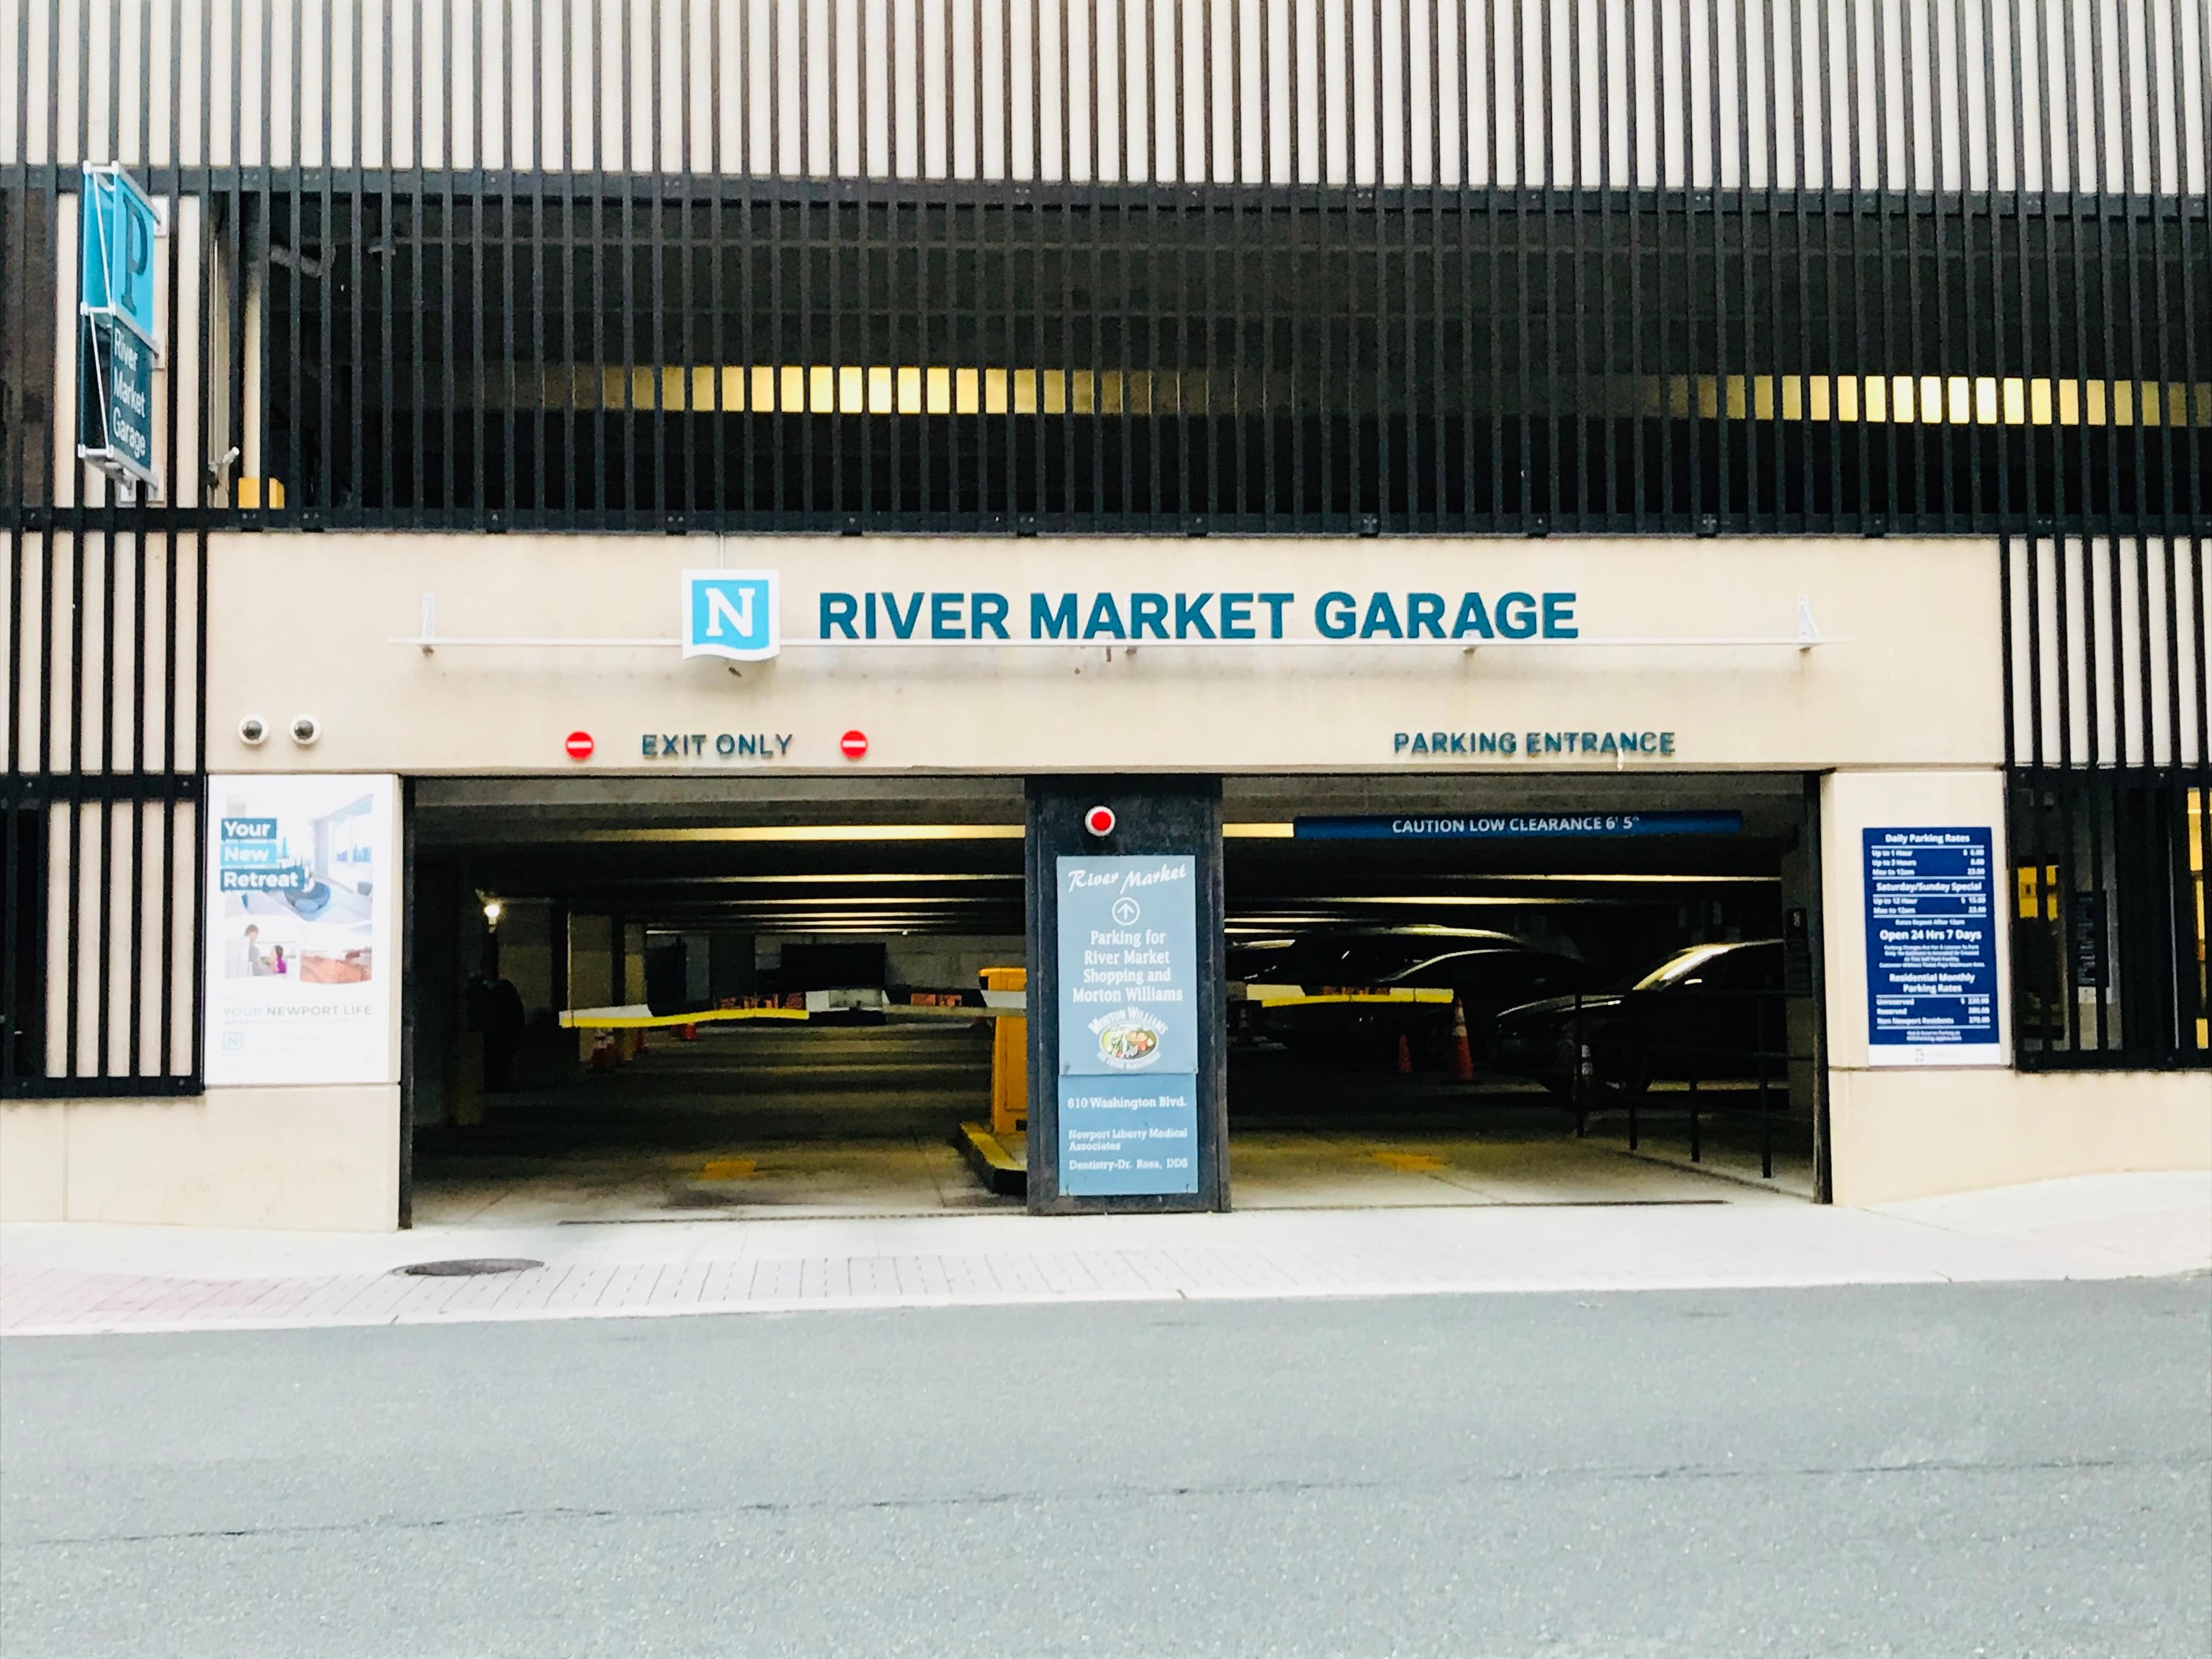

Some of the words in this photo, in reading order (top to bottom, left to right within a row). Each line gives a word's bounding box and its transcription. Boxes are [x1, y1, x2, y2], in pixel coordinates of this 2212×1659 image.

[121, 192, 147, 316] P
[113, 331, 138, 372] River
[113, 369, 145, 418] Market
[112, 406, 146, 457] Garage
[706, 588, 755, 638] N
[820, 592, 1011, 640] RIVER
[1031, 592, 1294, 639] MARKET
[1313, 592, 1579, 639] GARAGE
[642, 734, 707, 756] EXIT
[715, 733, 793, 756] ONLY
[1394, 732, 1517, 755] PARKING
[1526, 732, 1676, 755] ENTRANCE
[224, 821, 271, 838] Your
[1392, 819, 1464, 833] CAUTION
[1469, 819, 1505, 832] LOW
[1509, 817, 1602, 831] CLEARANCE
[1885, 834, 1908, 844] Daily
[1909, 834, 1944, 844] Parking
[1945, 834, 1970, 842] Rates
[224, 846, 269, 862] New
[224, 870, 298, 888] Retreat
[1067, 869, 1119, 893] River
[1119, 863, 1188, 895] Market
[1876, 882, 1950, 892] Saturday/Sunday
[1951, 881, 1982, 892] Special
[1090, 929, 1141, 948] Parking
[1145, 929, 1166, 945] for
[1880, 929, 1909, 942] Open
[1910, 929, 1924, 940] 24
[1926, 929, 1945, 940] Hrs
[1946, 929, 1953, 940] 7
[1955, 929, 1982, 942] Days
[1084, 949, 1120, 965] River
[1123, 949, 1170, 964] Market
[1083, 968, 1144, 986] Shopping
[1147, 967, 1171, 982] and
[1889, 973, 1937, 982] Residential
[1939, 972, 1976, 983] Monthly
[1073, 987, 1121, 1003] Morton
[1125, 986, 1183, 1002] Williams
[1903, 984, 1937, 994] Parking
[1938, 983, 1963, 993] Rates
[223, 1006, 262, 1017] YOUR
[267, 1005, 339, 1016] NEWPORT
[343, 1005, 372, 1016] LIFE
[1067, 1097, 1088, 1109] 610
[1089, 1096, 1156, 1111] Washington
[1158, 1096, 1188, 1107] Blvd.
[1069, 1129, 1111, 1141] Newport
[1112, 1128, 1147, 1141] Liberty
[1149, 1127, 1188, 1138] Medical
[1069, 1141, 1121, 1152] Associates
[1166, 1157, 1189, 1169] DDS
